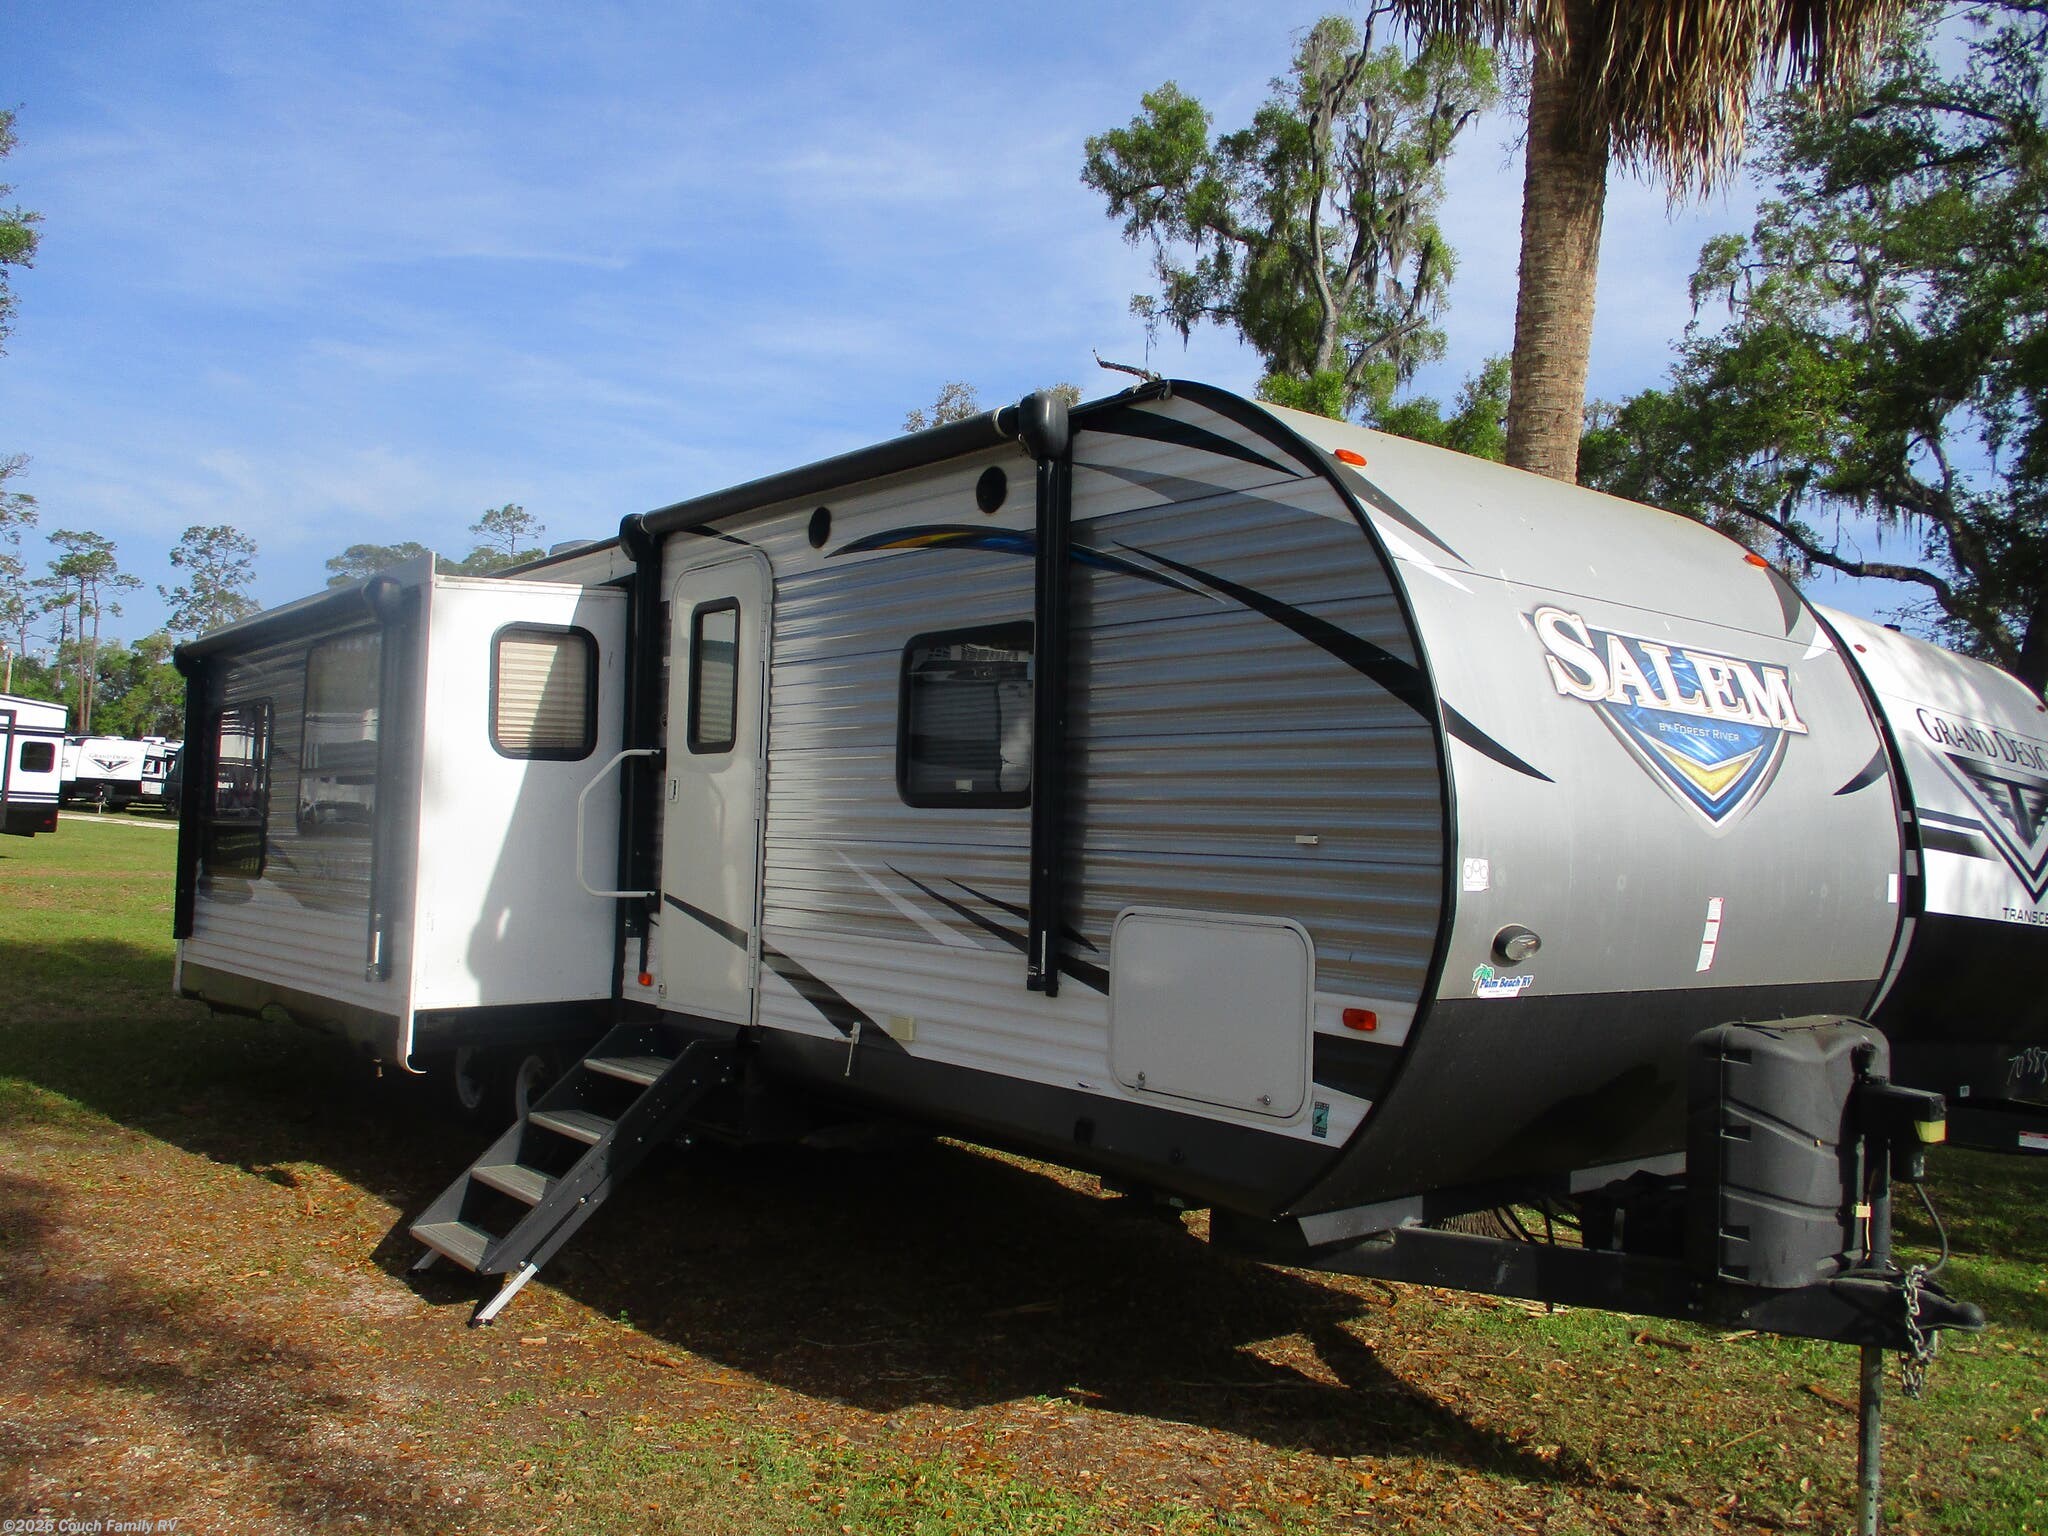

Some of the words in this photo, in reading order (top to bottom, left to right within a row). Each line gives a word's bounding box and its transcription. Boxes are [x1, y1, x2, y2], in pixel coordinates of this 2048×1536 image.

[1535, 606, 1808, 733] SALEM
[1674, 723, 1710, 738] FOREST
[1712, 729, 1740, 742] RIVER
[1916, 707, 1998, 758] GRAND
[1480, 979, 1499, 988] Palm
[1499, 978, 1520, 988] Beach
[1521, 976, 1533, 987] RV
